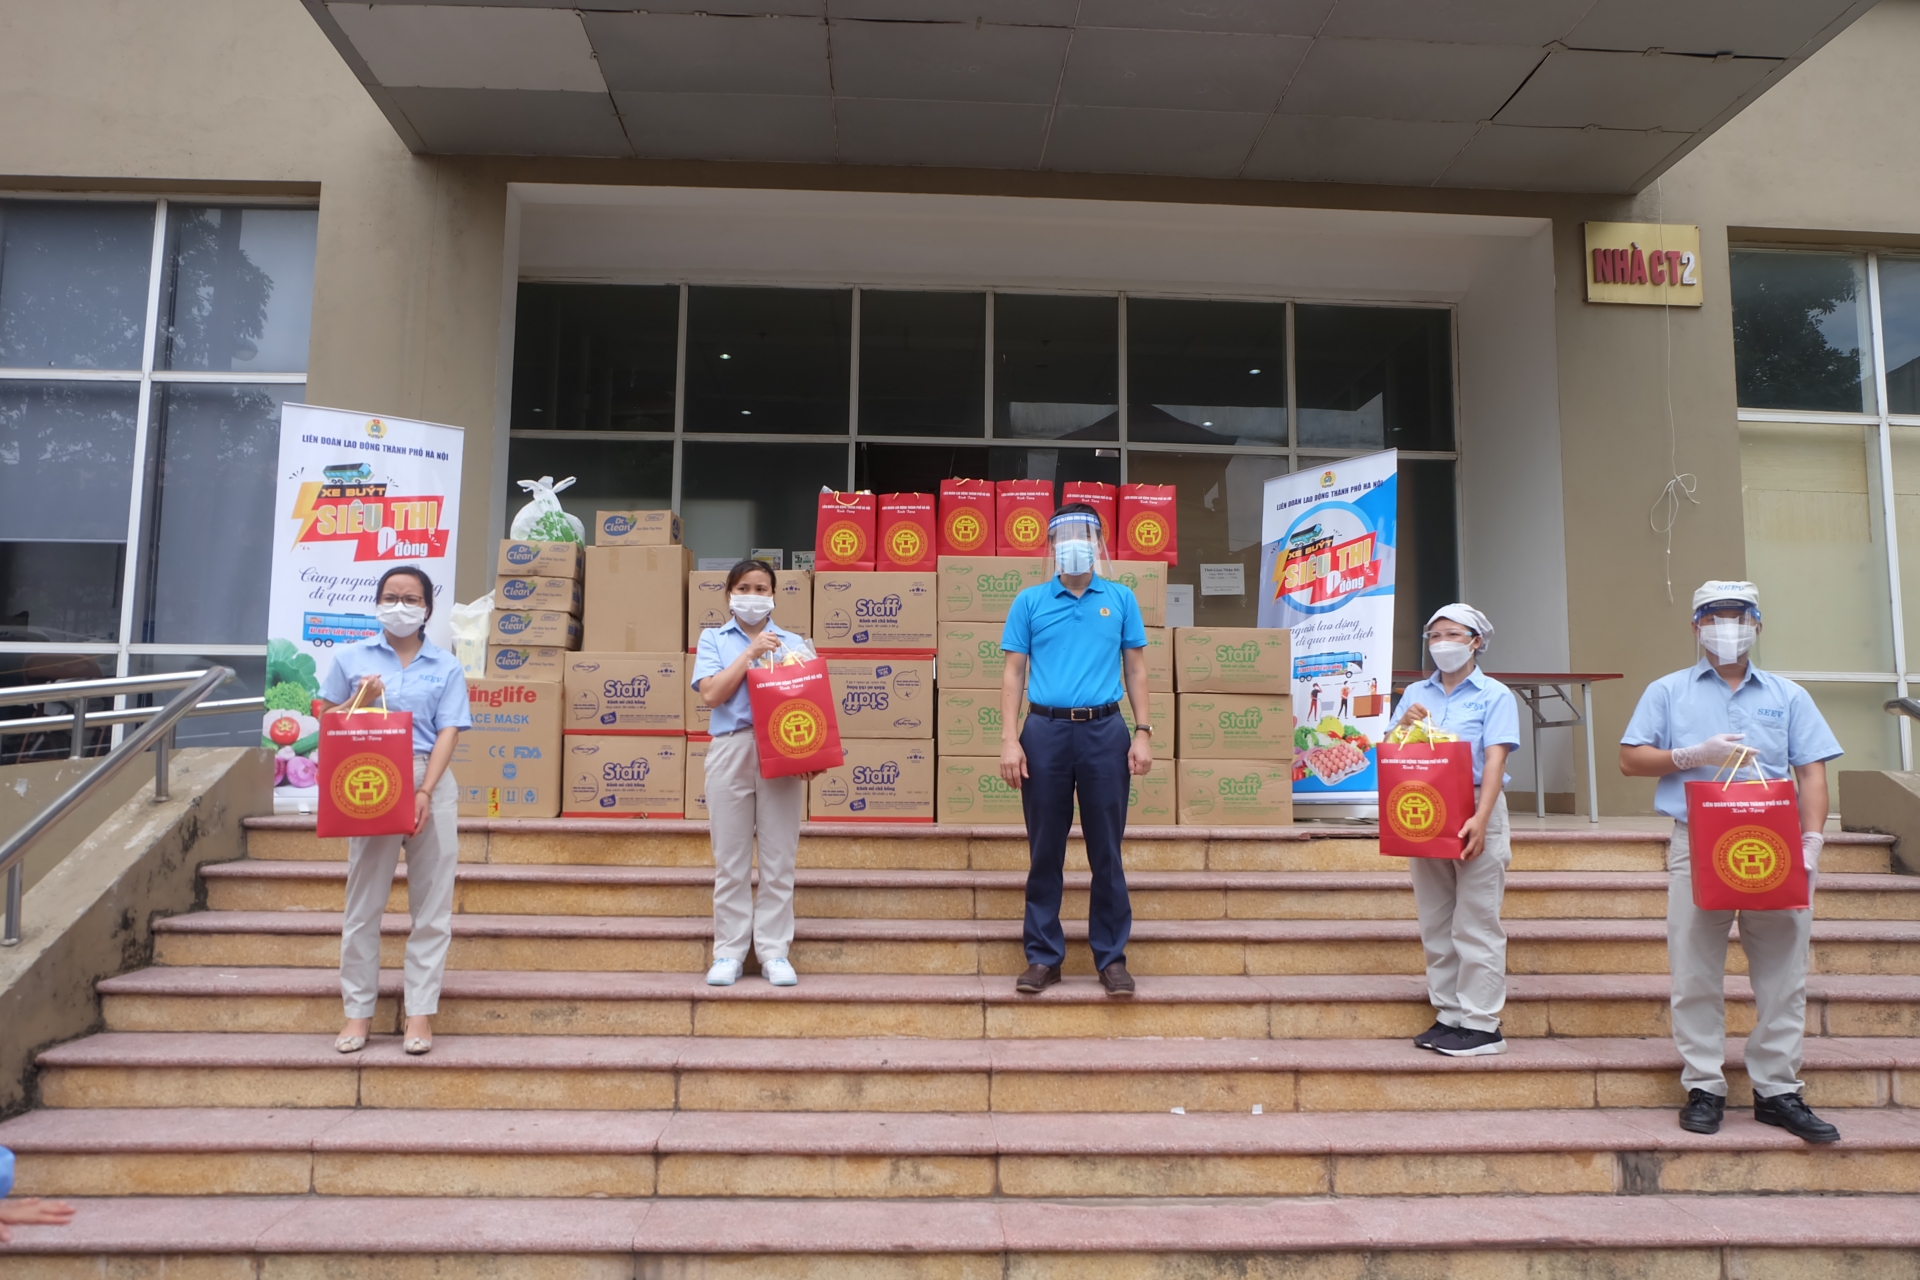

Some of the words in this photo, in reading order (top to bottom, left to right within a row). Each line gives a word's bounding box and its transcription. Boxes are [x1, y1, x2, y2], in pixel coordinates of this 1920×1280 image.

[1592, 241, 1648, 285] NHÀ
[1649, 249, 1697, 287] CT2
[321, 488, 341, 497] XE
[345, 485, 386, 497] BUÝT
[317, 499, 383, 535] SIÊU
[391, 501, 438, 534] THỊ
[604, 523, 630, 531] Clean
[615, 517, 624, 525] Dr
[507, 551, 533, 560] Clean
[1288, 549, 1302, 560] XE
[1305, 539, 1333, 555] BUÝT
[1284, 552, 1331, 589] SIÊU
[1337, 538, 1372, 569] THỊ
[299, 567, 338, 590] Cùng
[976, 571, 1021, 592] Staff
[309, 586, 325, 599] di
[327, 592, 357, 607] qua
[503, 587, 530, 596] Clean
[855, 595, 901, 617] Staff
[499, 621, 525, 630] Clean
[1317, 620, 1333, 632] lao
[1335, 618, 1360, 632] động
[1296, 635, 1306, 646] di
[1307, 637, 1326, 649] qua
[1328, 633, 1351, 643] mùa
[1353, 626, 1374, 641] dịch
[978, 641, 1006, 659] Sta
[1215, 641, 1260, 662] Staff
[496, 656, 522, 666] Clean
[468, 686, 538, 708] inglife
[603, 676, 649, 698] Staff
[842, 692, 889, 713] Staff
[1757, 708, 1784, 718] SEEV
[494, 714, 529, 724] MASK
[1218, 707, 1262, 729] Staff
[513, 746, 542, 759] FDA
[602, 758, 649, 781] Staff
[852, 762, 899, 785] Staff
[1218, 773, 1261, 795] Staff
